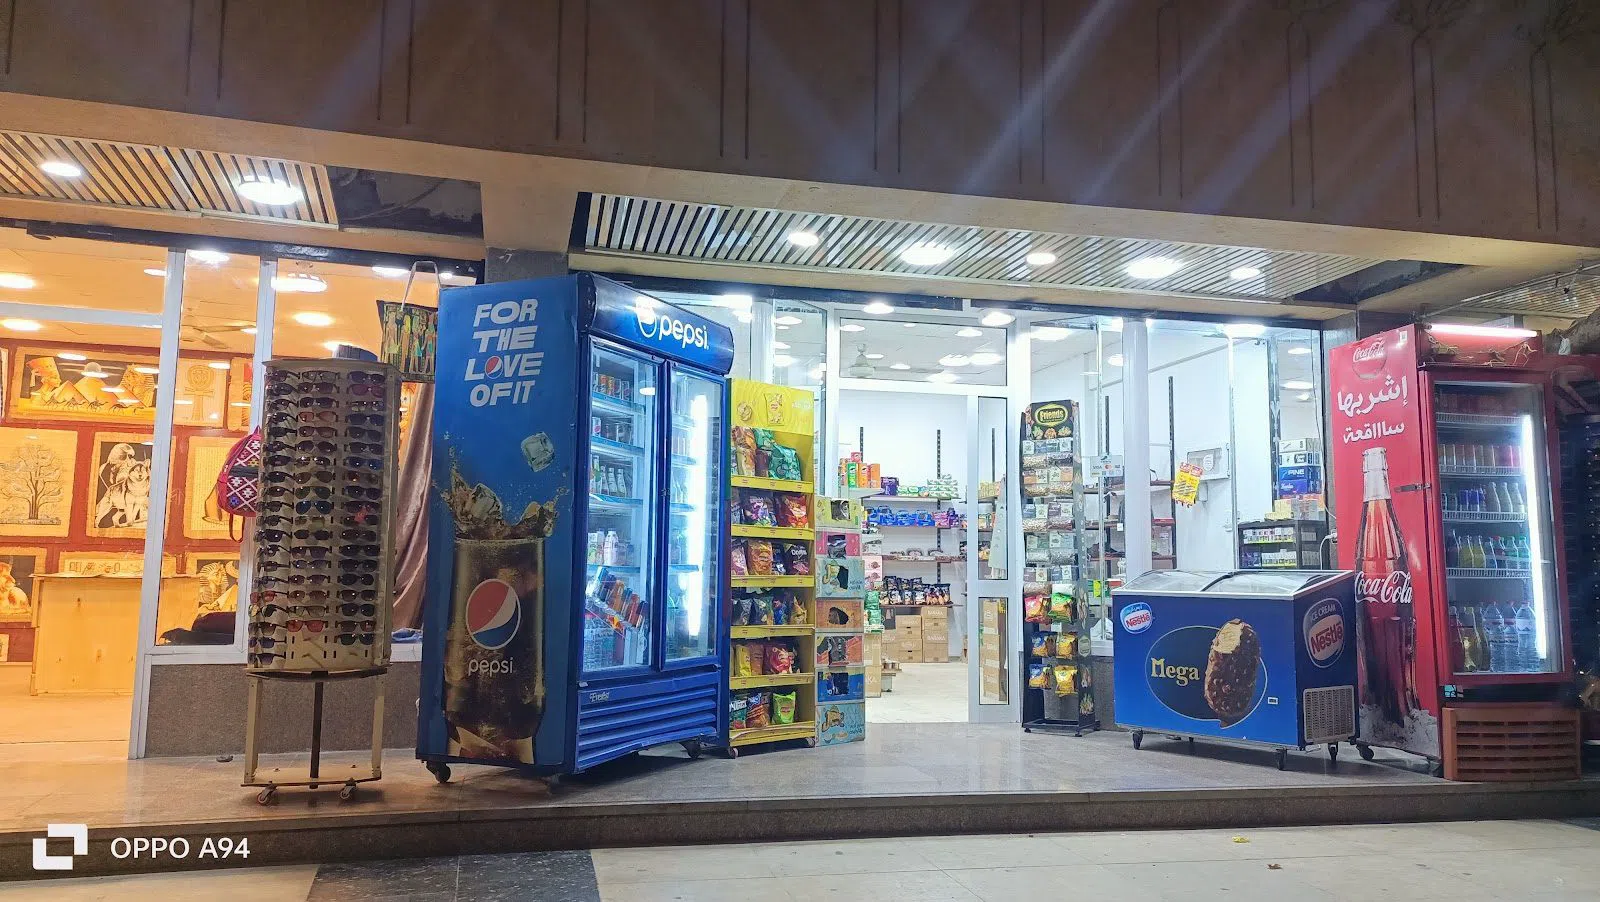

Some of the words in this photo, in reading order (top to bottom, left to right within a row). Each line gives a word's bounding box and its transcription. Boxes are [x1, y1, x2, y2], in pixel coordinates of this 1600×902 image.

[473, 299, 538, 327] FOR
[472, 325, 538, 352] THE
[658, 314, 707, 349] pepsi
[464, 352, 544, 381] LOVE
[470, 382, 513, 407] OF
[512, 380, 535, 404] IT
[1337, 375, 1408, 417] إشربها
[1355, 571, 1412, 604] Coca-Cola
[468, 656, 514, 677] pepsi
[1150, 656, 1200, 687] Mega
